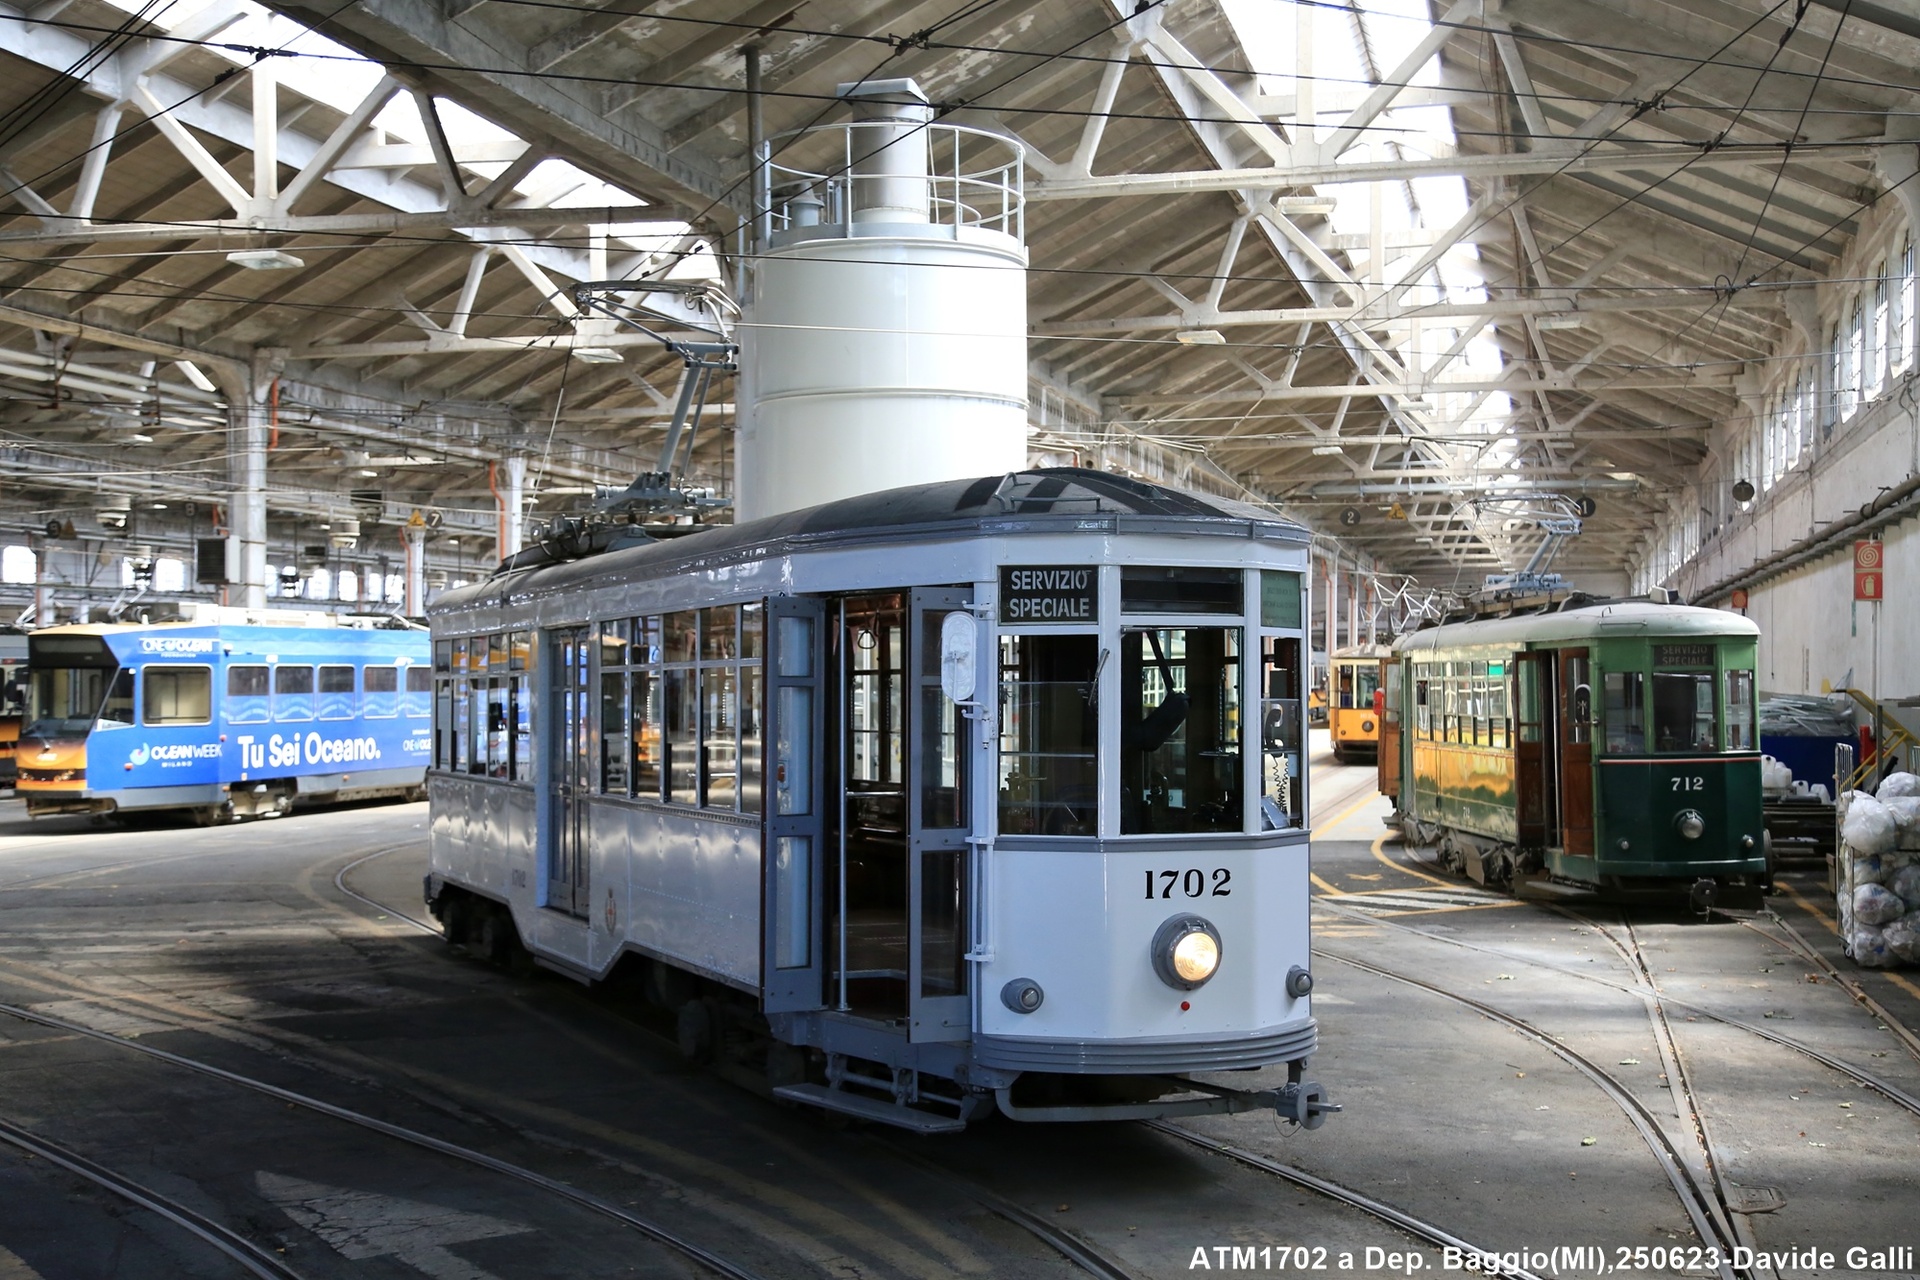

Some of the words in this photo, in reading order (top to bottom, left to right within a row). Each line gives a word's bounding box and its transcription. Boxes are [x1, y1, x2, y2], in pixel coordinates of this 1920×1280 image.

[1581, 500, 1588, 515] 1
[431, 513, 440, 526] 7
[1347, 510, 1355, 524] 2
[1010, 570, 1089, 590] SERVIZIO
[1009, 598, 1090, 618] SPECIALE
[1662, 645, 1708, 655] SERVIZIO
[1662, 656, 1707, 666] SPECIALE
[150, 744, 193, 760] OCEAN
[193, 743, 223, 759] WEEK
[237, 735, 265, 769] Tu
[268, 732, 300, 767] Sei
[304, 731, 382, 765] Oceano.
[1670, 776, 1704, 791] 712
[1144, 867, 1231, 900] 1702
